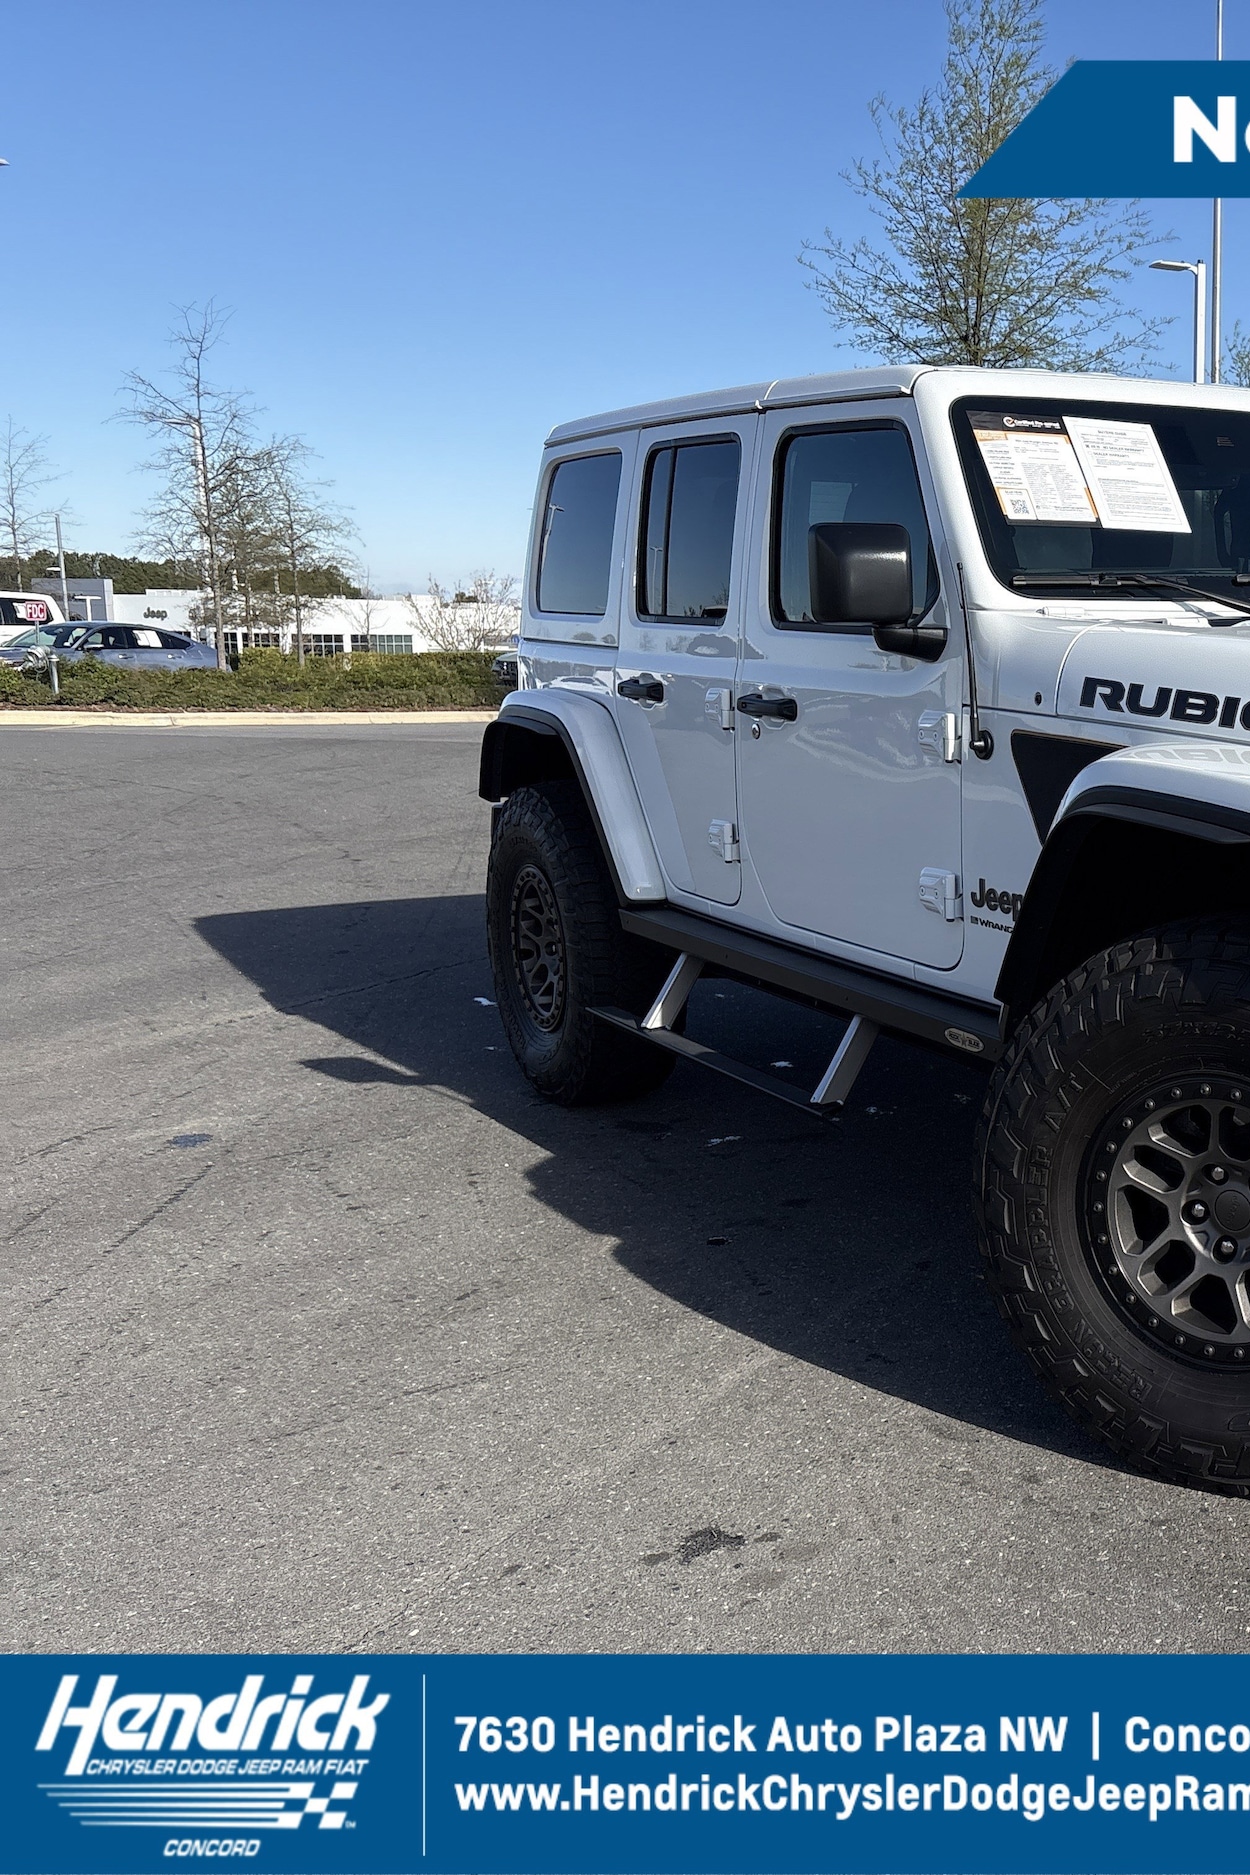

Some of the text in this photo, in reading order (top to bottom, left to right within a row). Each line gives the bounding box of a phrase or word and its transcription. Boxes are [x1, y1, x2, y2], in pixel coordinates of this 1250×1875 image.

[26, 603, 45, 618] FDC
[143, 606, 168, 621] Jeep
[971, 877, 1023, 922] Jeep
[979, 917, 1014, 933] WRANG
[1023, 1143, 1076, 1314] GRAPPLER
